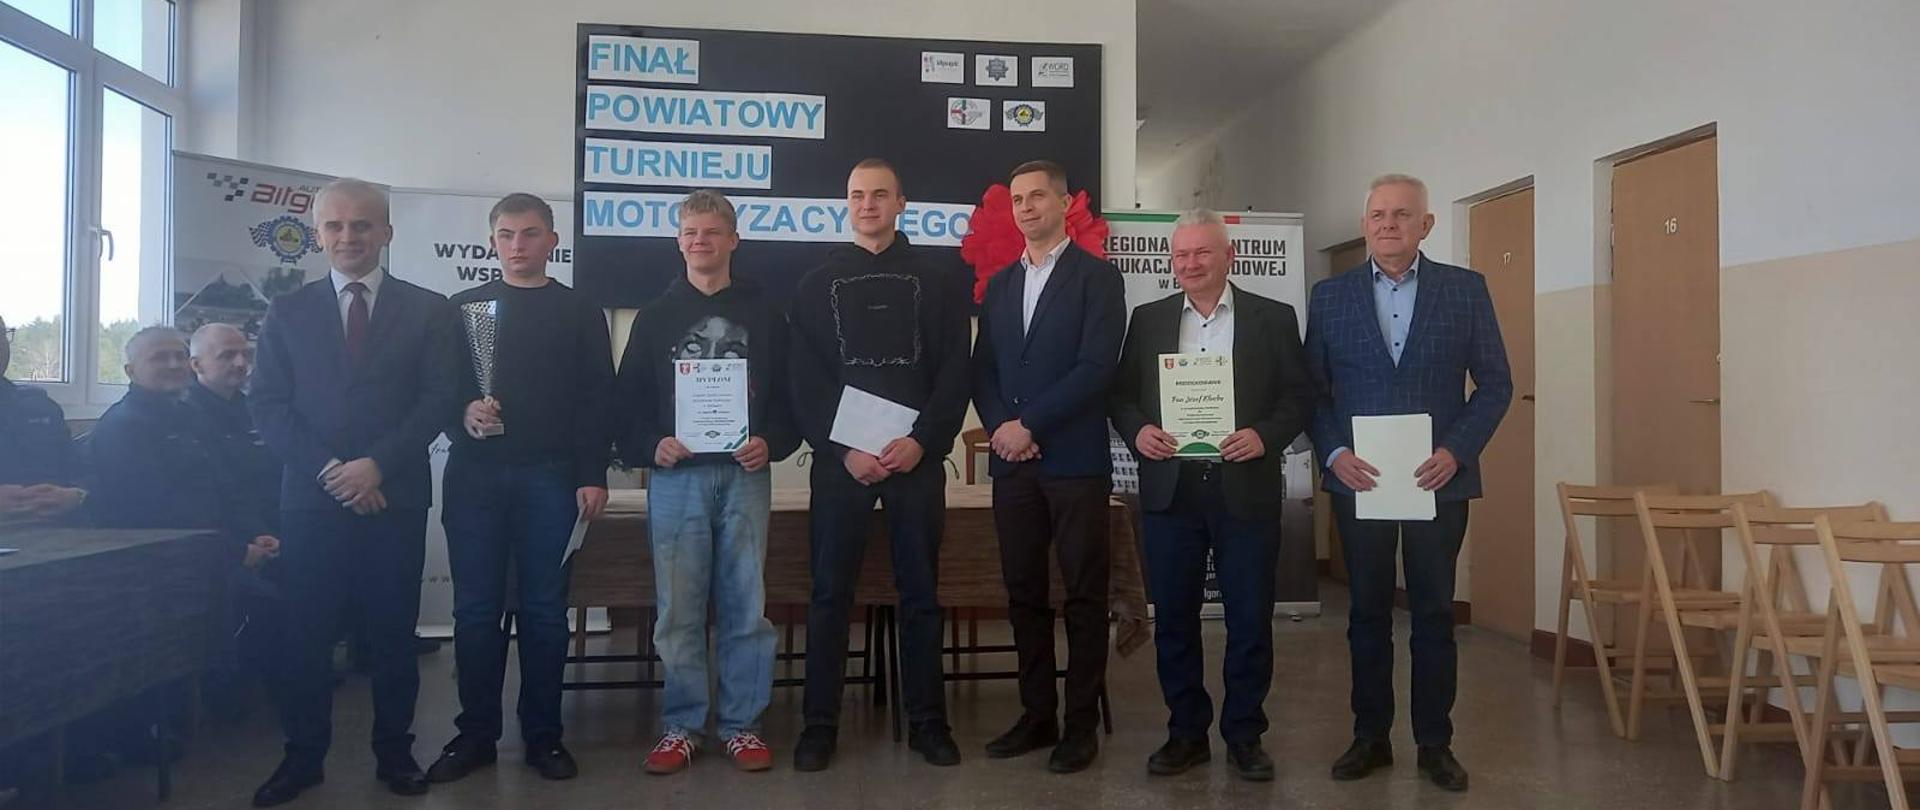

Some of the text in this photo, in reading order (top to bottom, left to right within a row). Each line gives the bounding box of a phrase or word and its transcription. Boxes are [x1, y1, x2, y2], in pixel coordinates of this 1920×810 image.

[590, 42, 697, 75] FINAŁ
[588, 93, 823, 130] POWIATOWY
[587, 146, 770, 181] TURNIEJU
[1664, 217, 1678, 234] 16
[1503, 252, 1511, 264] 17
